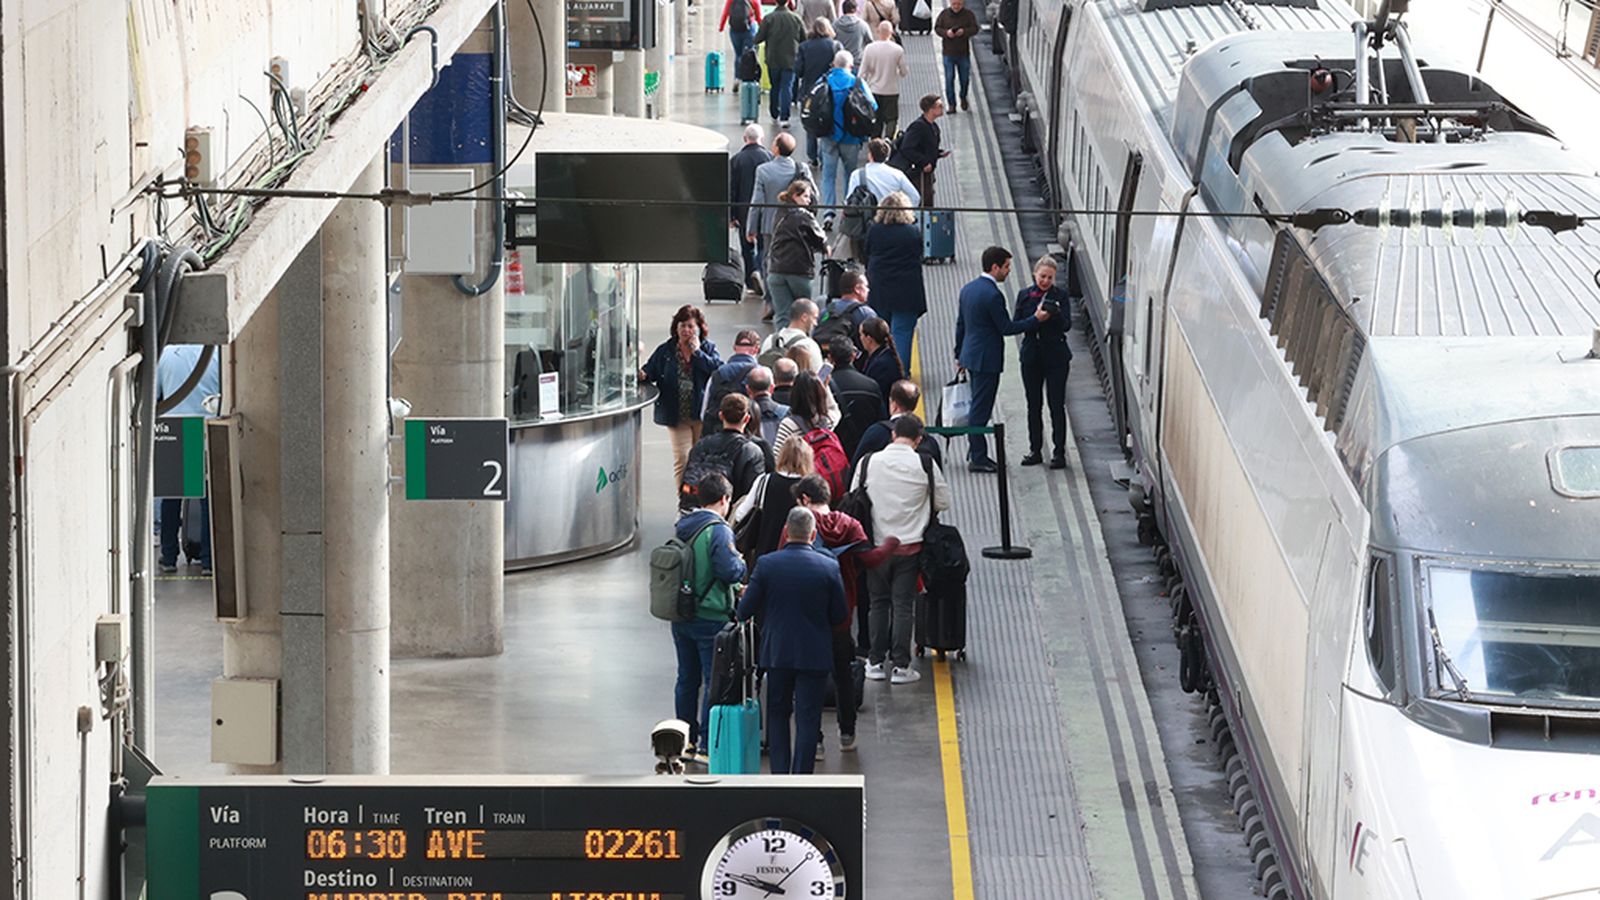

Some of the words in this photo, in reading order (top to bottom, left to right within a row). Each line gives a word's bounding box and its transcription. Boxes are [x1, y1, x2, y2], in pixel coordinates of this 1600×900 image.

[430, 425, 446, 436] Vía
[483, 460, 502, 496] 2
[1531, 788, 1600, 806] ren
[209, 804, 241, 824] Vía
[304, 807, 349, 824] Hora
[373, 813, 400, 824] TIME
[424, 807, 467, 824] Tren
[493, 813, 526, 824] TRAIN
[209, 837, 267, 849] PLATFORM
[307, 829, 406, 859] 06:30
[426, 829, 486, 859] AVE
[584, 829, 681, 859] 02261
[762, 837, 786, 853] 12
[304, 868, 378, 887] Destino
[402, 876, 473, 887] DESTINATION
[756, 866, 790, 874] FESTINA
[721, 881, 737, 896] 9
[810, 881, 826, 896] 3
